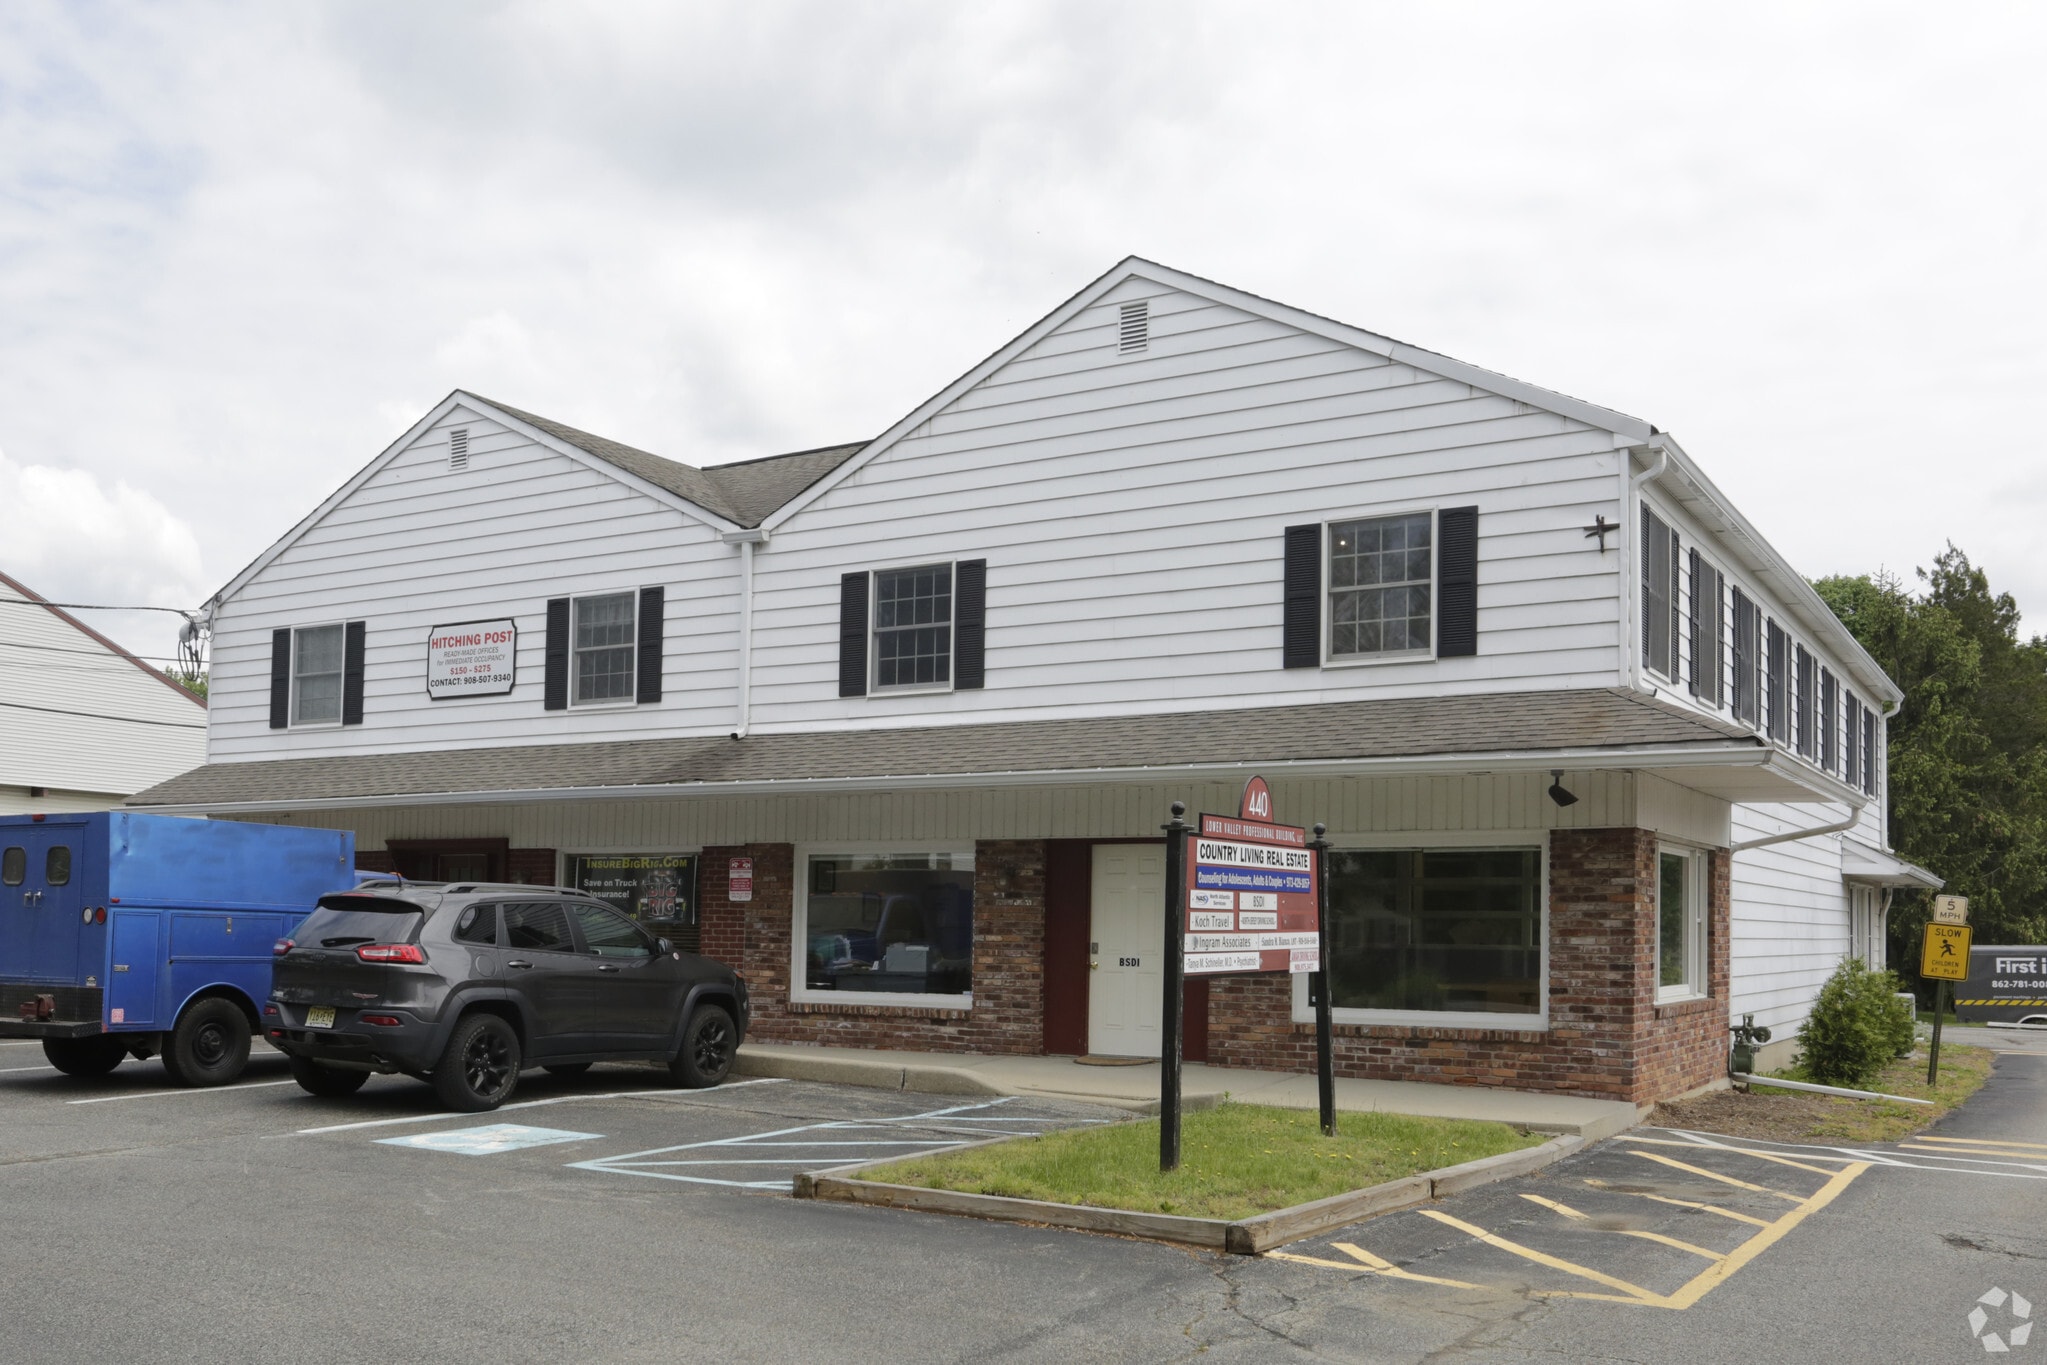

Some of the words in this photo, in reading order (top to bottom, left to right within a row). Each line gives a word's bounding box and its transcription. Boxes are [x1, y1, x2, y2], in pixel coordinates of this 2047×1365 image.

[431, 633, 481, 649] HITCHING
[484, 630, 513, 644] POST
[443, 648, 476, 658] READY-MADE
[477, 646, 499, 655] OFFICES
[445, 657, 473, 665] IMMEDIATE
[474, 654, 506, 663] OCCUPANCY
[474, 664, 491, 673] $275
[430, 677, 462, 687] CONTACT:
[463, 673, 511, 685] 908-507-9340
[1249, 791, 1268, 817] 440
[1205, 820, 1222, 833] LOWER
[1224, 822, 1242, 835] VALLEY
[1243, 825, 1275, 839] PROFESSIONAL
[1200, 843, 1238, 861] COUNTRY
[1240, 847, 1264, 864] LIVING
[1266, 850, 1284, 866] REAL
[1286, 852, 1308, 868] ESTATE
[583, 878, 601, 887] Save
[603, 879, 613, 887] on
[614, 878, 637, 887] Truck
[590, 890, 630, 898] Insurance!
[647, 882, 678, 897] BIG
[648, 898, 676, 916] RIG
[1253, 895, 1265, 908] BSDI
[1947, 900, 1956, 911] 5
[1195, 915, 1209, 928] Koch
[1211, 915, 1230, 928] Travel
[1940, 911, 1960, 920] MPH
[1935, 928, 1962, 938] SLOW
[1199, 935, 1220, 950] Ingram
[1222, 936, 1251, 948] Associates
[1119, 957, 1140, 967] BSDI
[1931, 960, 1959, 968] CHILDREN
[1996, 957, 2037, 973] First
